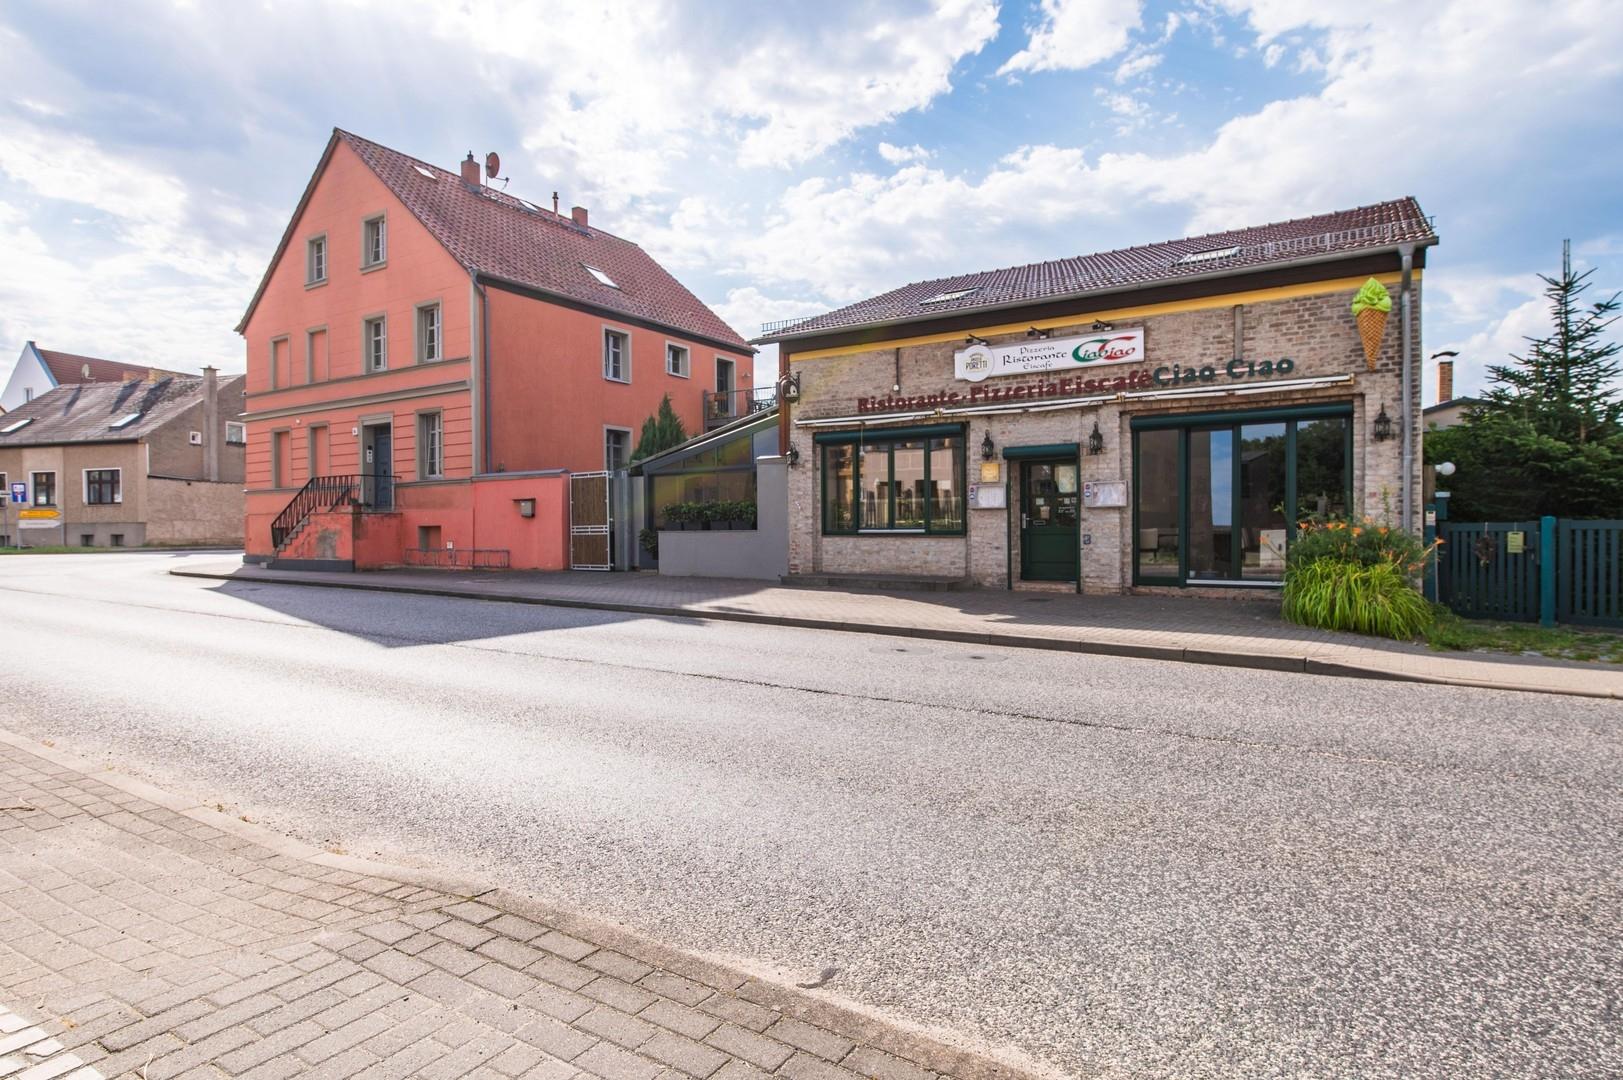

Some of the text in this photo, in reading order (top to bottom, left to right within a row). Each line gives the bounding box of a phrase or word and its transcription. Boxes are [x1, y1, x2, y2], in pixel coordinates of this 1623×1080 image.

[1002, 351, 1067, 366] Ristorante
[970, 379, 1057, 402] Pizzeria
[1060, 369, 1153, 395] Eiscafé
[1153, 364, 1216, 386] Ciao
[1227, 358, 1294, 380] Ciao
